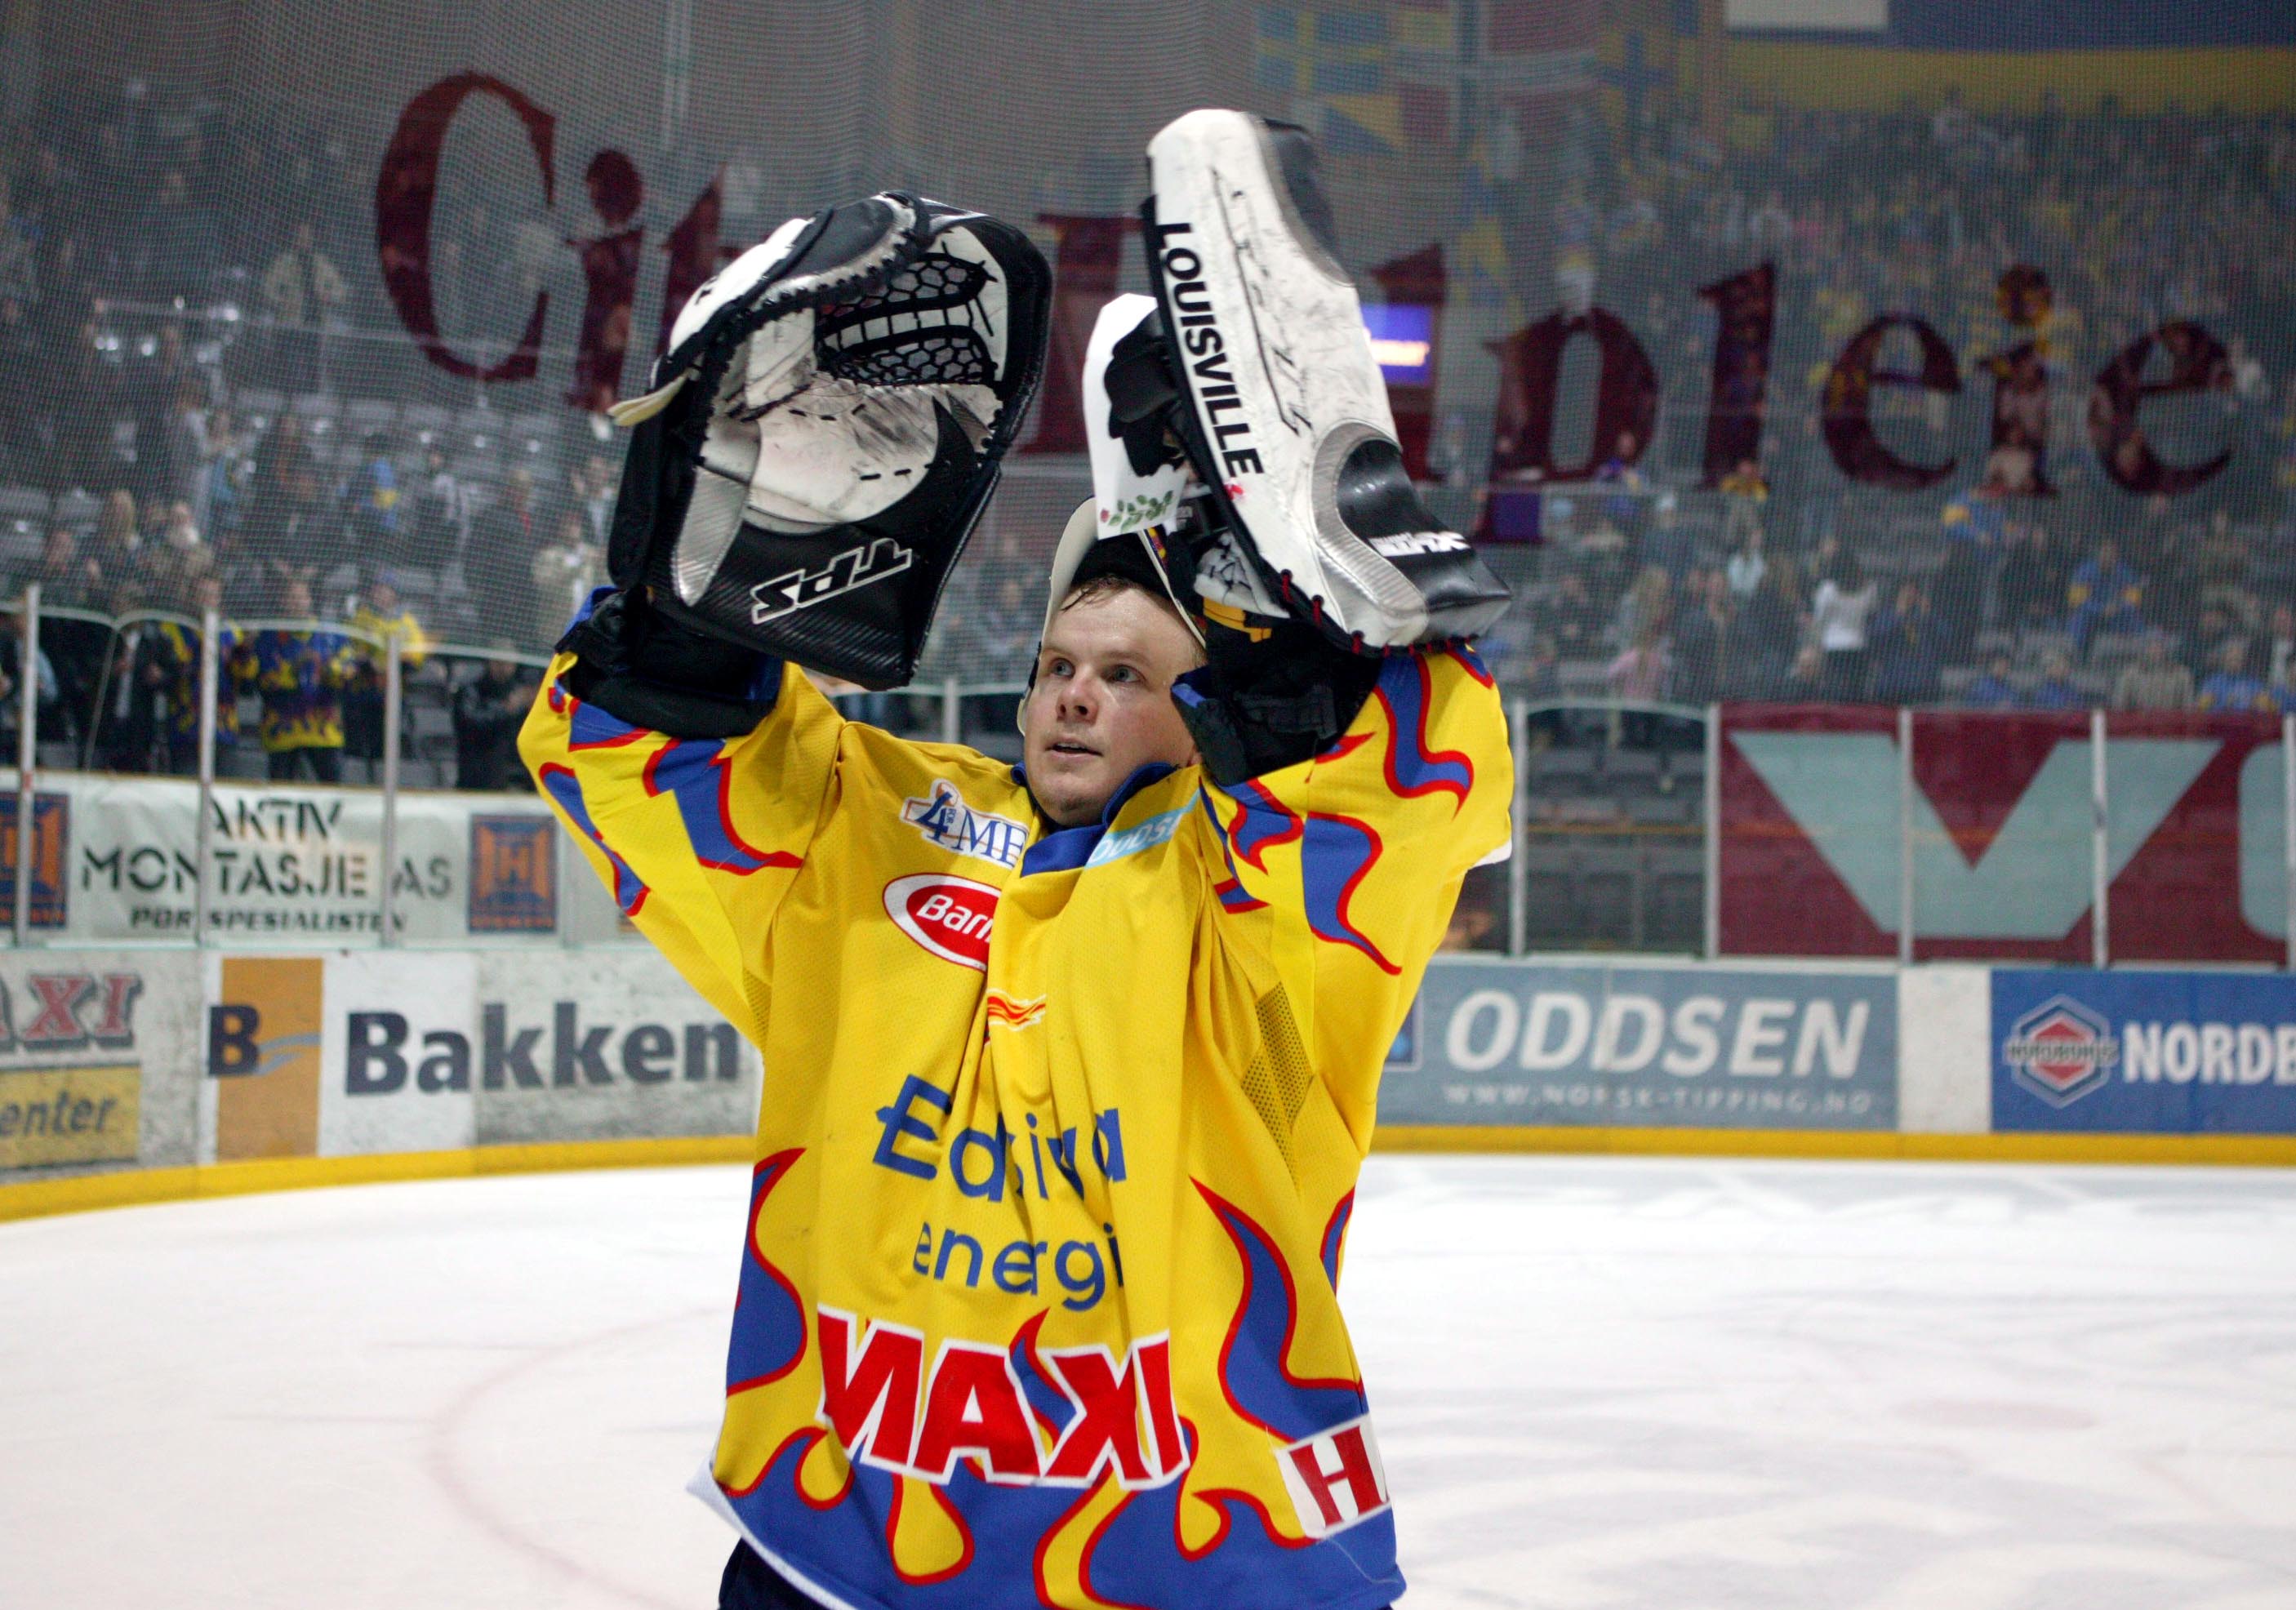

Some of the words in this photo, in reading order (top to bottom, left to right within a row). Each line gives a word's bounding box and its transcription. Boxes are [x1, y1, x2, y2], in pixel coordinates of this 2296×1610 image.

[1154, 222, 1265, 478] LOUISVILLE
[83, 844, 366, 897] MONTASJE
[392, 856, 452, 899] AS
[209, 1004, 260, 1076] B
[345, 1001, 740, 1096] Bakken
[1444, 989, 1871, 1079] ODDSEN
[913, 1221, 1124, 1312] energi
[1288, 1425, 1390, 1528] H
